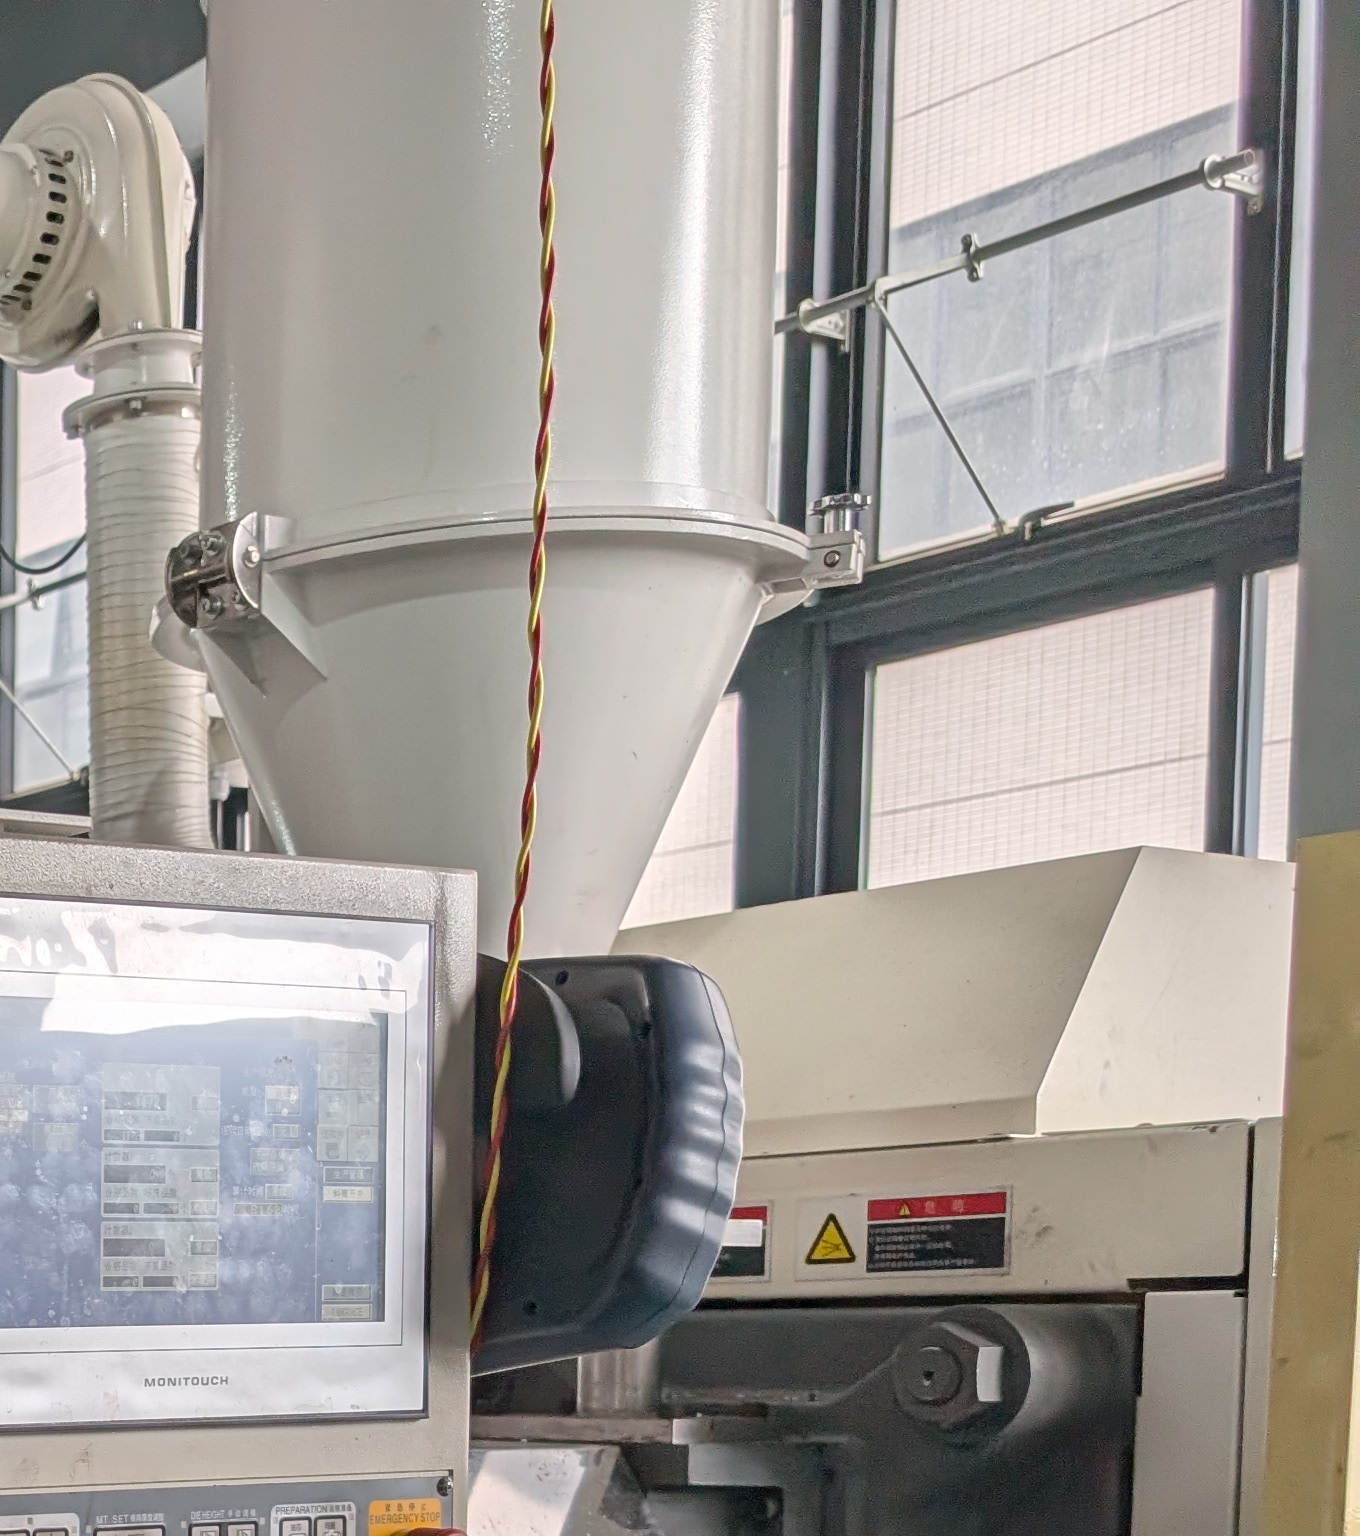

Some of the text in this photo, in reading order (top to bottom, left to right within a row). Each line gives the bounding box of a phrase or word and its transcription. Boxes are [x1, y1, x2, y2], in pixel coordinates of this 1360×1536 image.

[144, 1376, 229, 1388] MONITOUCH
[201, 1510, 225, 1519] HEIGHT
[275, 1505, 328, 1514] PREPARATION
[112, 1514, 128, 1524] SET
[370, 1512, 441, 1524] EMERGENCY STOP
